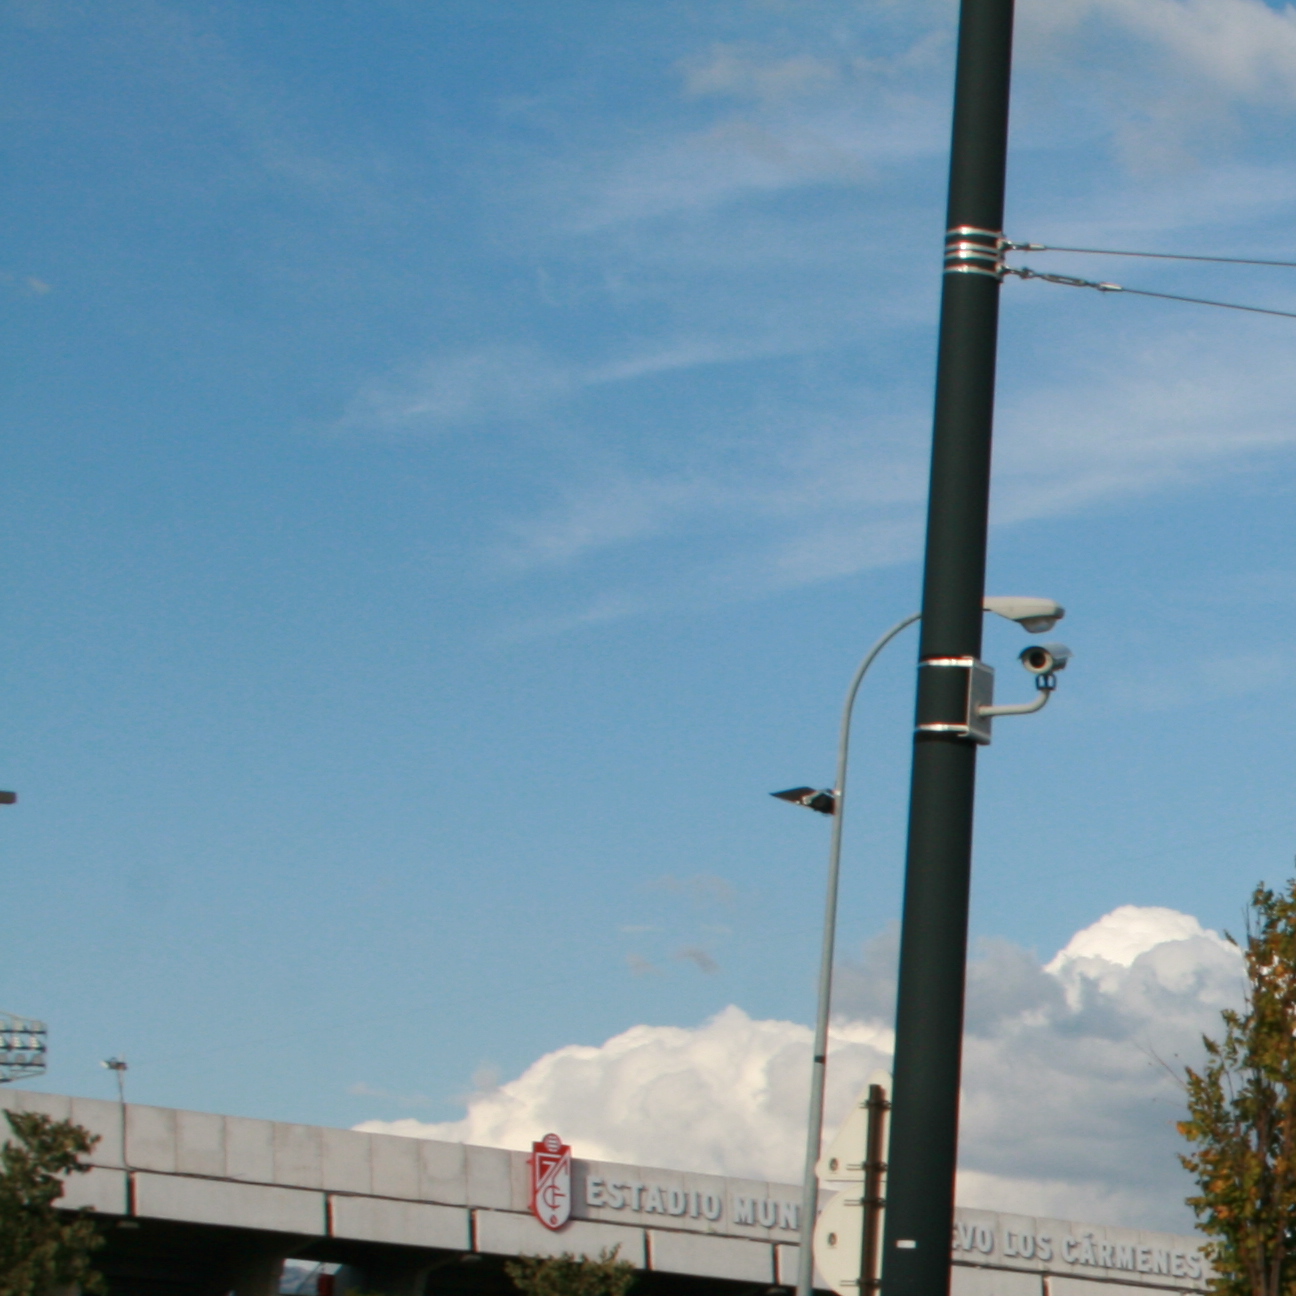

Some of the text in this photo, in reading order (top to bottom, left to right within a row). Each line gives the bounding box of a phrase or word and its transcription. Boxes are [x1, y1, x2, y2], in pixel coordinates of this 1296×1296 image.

[586, 1176, 722, 1221] ESTADIO
[733, 1196, 801, 1230] MUN
[1003, 1228, 1053, 1262] LOS
[1061, 1231, 1203, 1279] CÁRMENES
